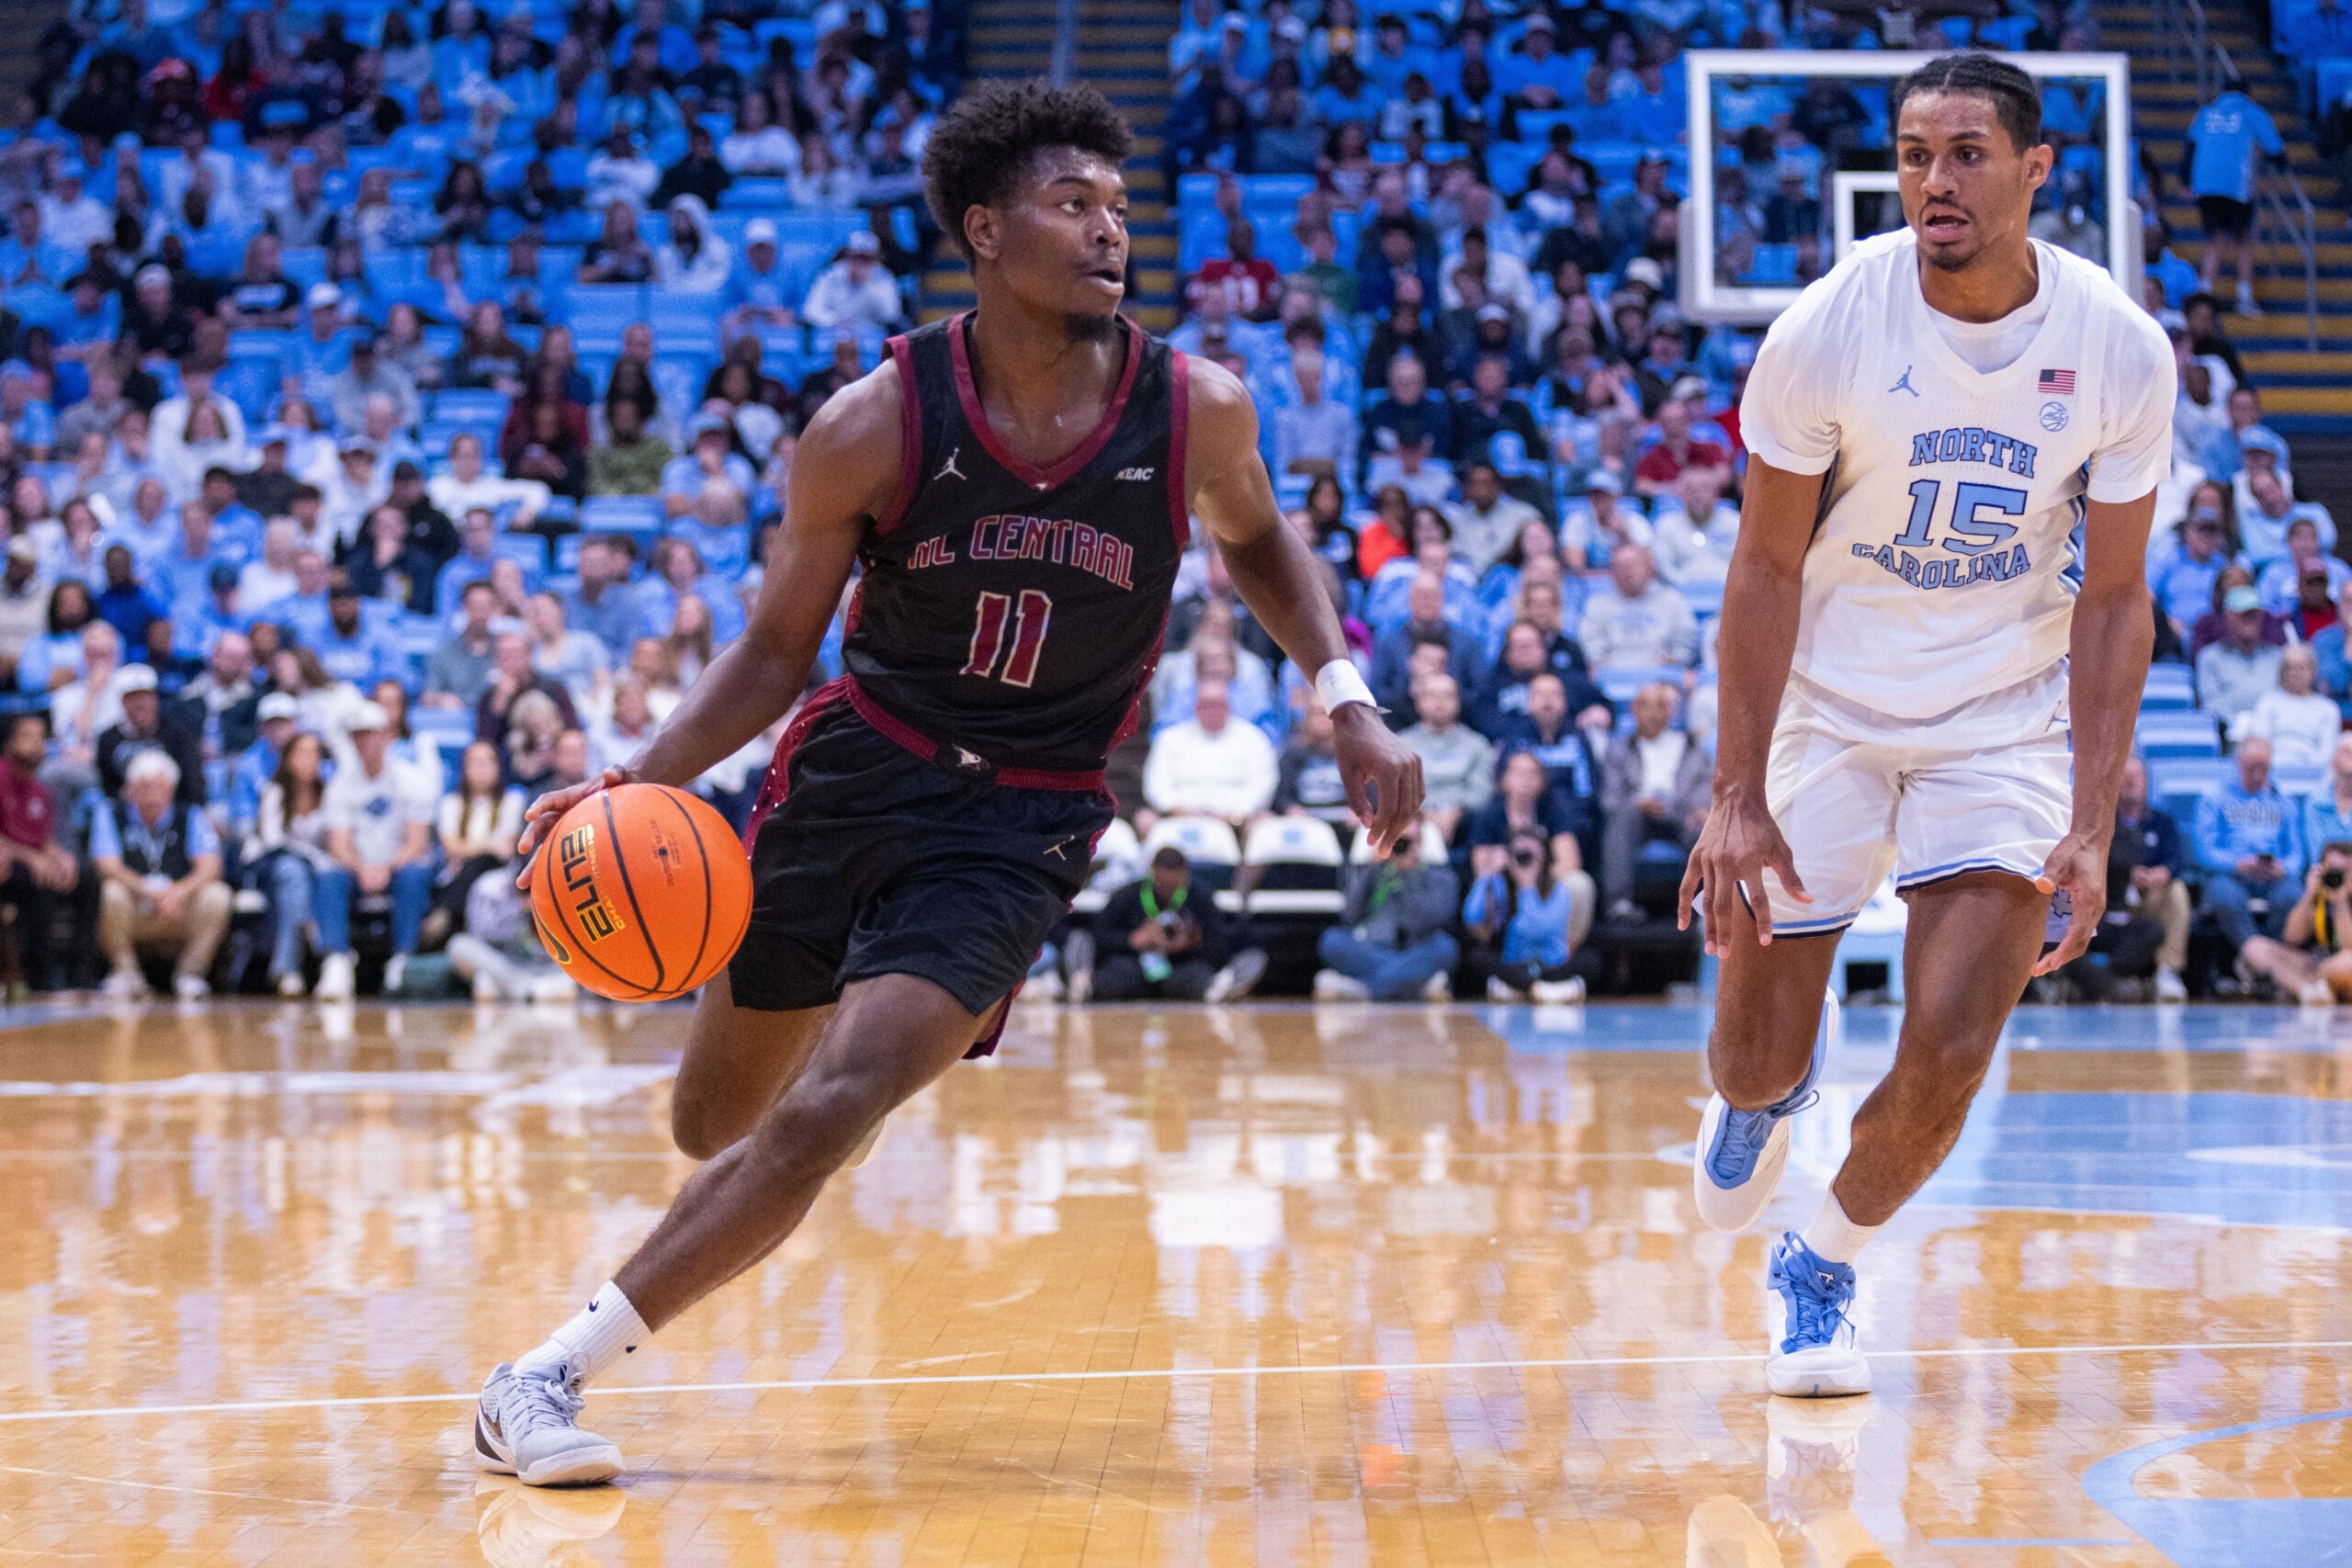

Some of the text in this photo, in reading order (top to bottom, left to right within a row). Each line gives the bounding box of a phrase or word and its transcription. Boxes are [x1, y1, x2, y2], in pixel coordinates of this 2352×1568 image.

[1908, 427, 2038, 479] NORTH
[969, 514, 1135, 591] CENTRAL
[1893, 479, 2028, 556] 15
[1851, 543, 2030, 590] CAROLINA
[959, 589, 1053, 688] 11
[560, 826, 617, 943] ELITE
